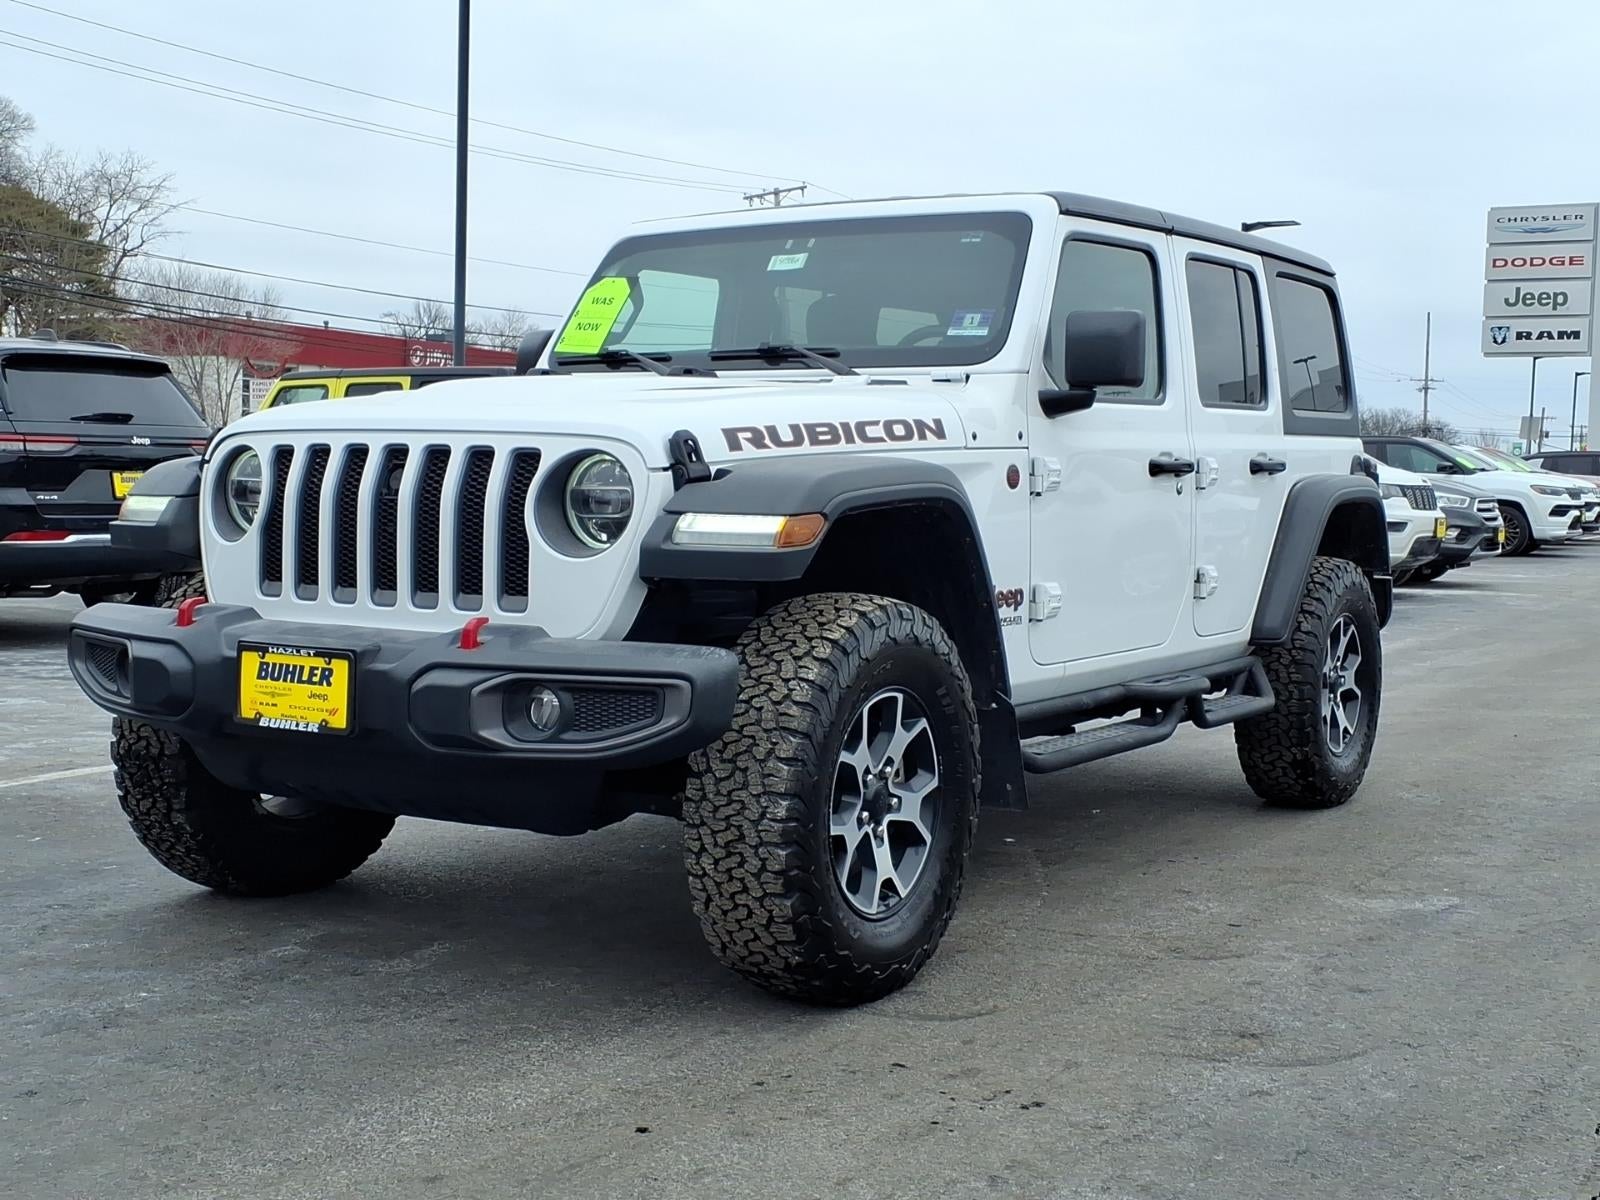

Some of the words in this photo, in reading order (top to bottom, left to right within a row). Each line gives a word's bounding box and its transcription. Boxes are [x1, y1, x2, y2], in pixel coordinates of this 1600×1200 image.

[1496, 214, 1584, 224] CHRYSLER
[1492, 255, 1585, 269] DODGE
[591, 296, 615, 306] WAS
[1504, 286, 1568, 311] Jeep
[575, 322, 602, 331] NOW
[1515, 330, 1581, 341] RAM
[130, 436, 150, 445] Jeep
[720, 418, 947, 453] RUBICON
[994, 587, 1024, 611] eep
[268, 646, 316, 657] HAZLET
[256, 661, 334, 687] BUHLER
[307, 690, 329, 702] Jeep
[289, 704, 331, 713] DODGE
[259, 716, 319, 733] BUHLER
